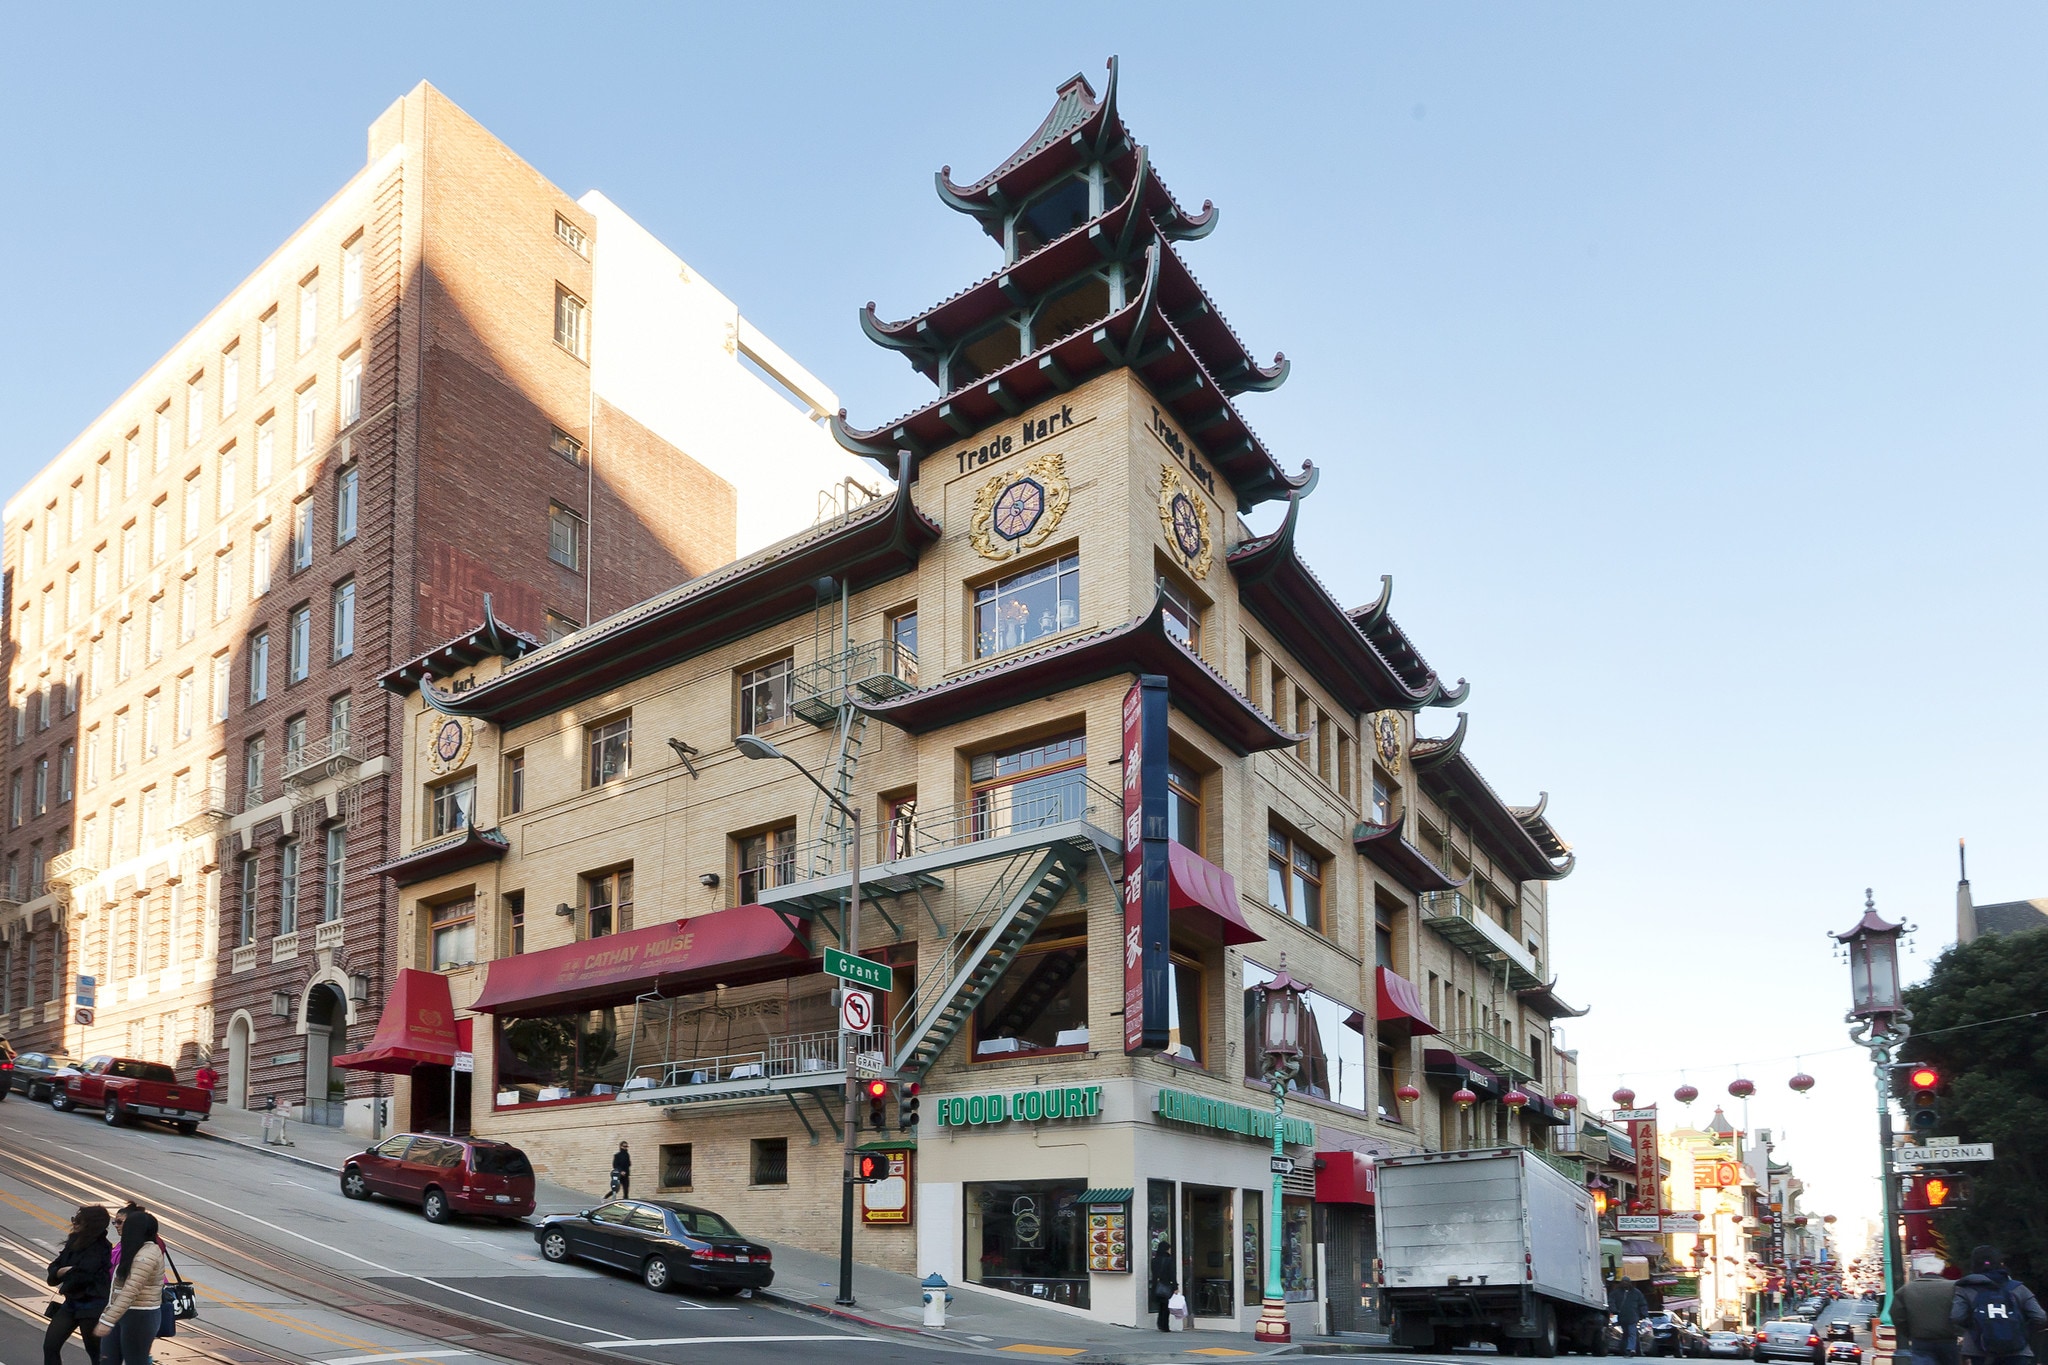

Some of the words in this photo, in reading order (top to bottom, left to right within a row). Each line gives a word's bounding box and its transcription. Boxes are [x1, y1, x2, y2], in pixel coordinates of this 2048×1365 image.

[956, 434, 1012, 474] Trade
[1023, 404, 1073, 445] Mark
[1151, 405, 1185, 461] Trade
[1188, 451, 1215, 497] Mark
[584, 945, 640, 970] CATHAY
[643, 933, 695, 959] HOUSE
[839, 958, 880, 982] Grant
[857, 1056, 881, 1070] GRANT
[937, 1093, 1007, 1126] FOOD
[1011, 1085, 1103, 1122] COURT
[1159, 1088, 1250, 1136] CHINATOWN
[1250, 1109, 1275, 1139] FOO
[1616, 1110, 1630, 1119] Far
[1633, 1109, 1654, 1118] East
[1903, 1147, 1985, 1160] CALIFORNIA
[1057, 1209, 1077, 1218] OPEN
[1987, 1303, 2009, 1319] H
